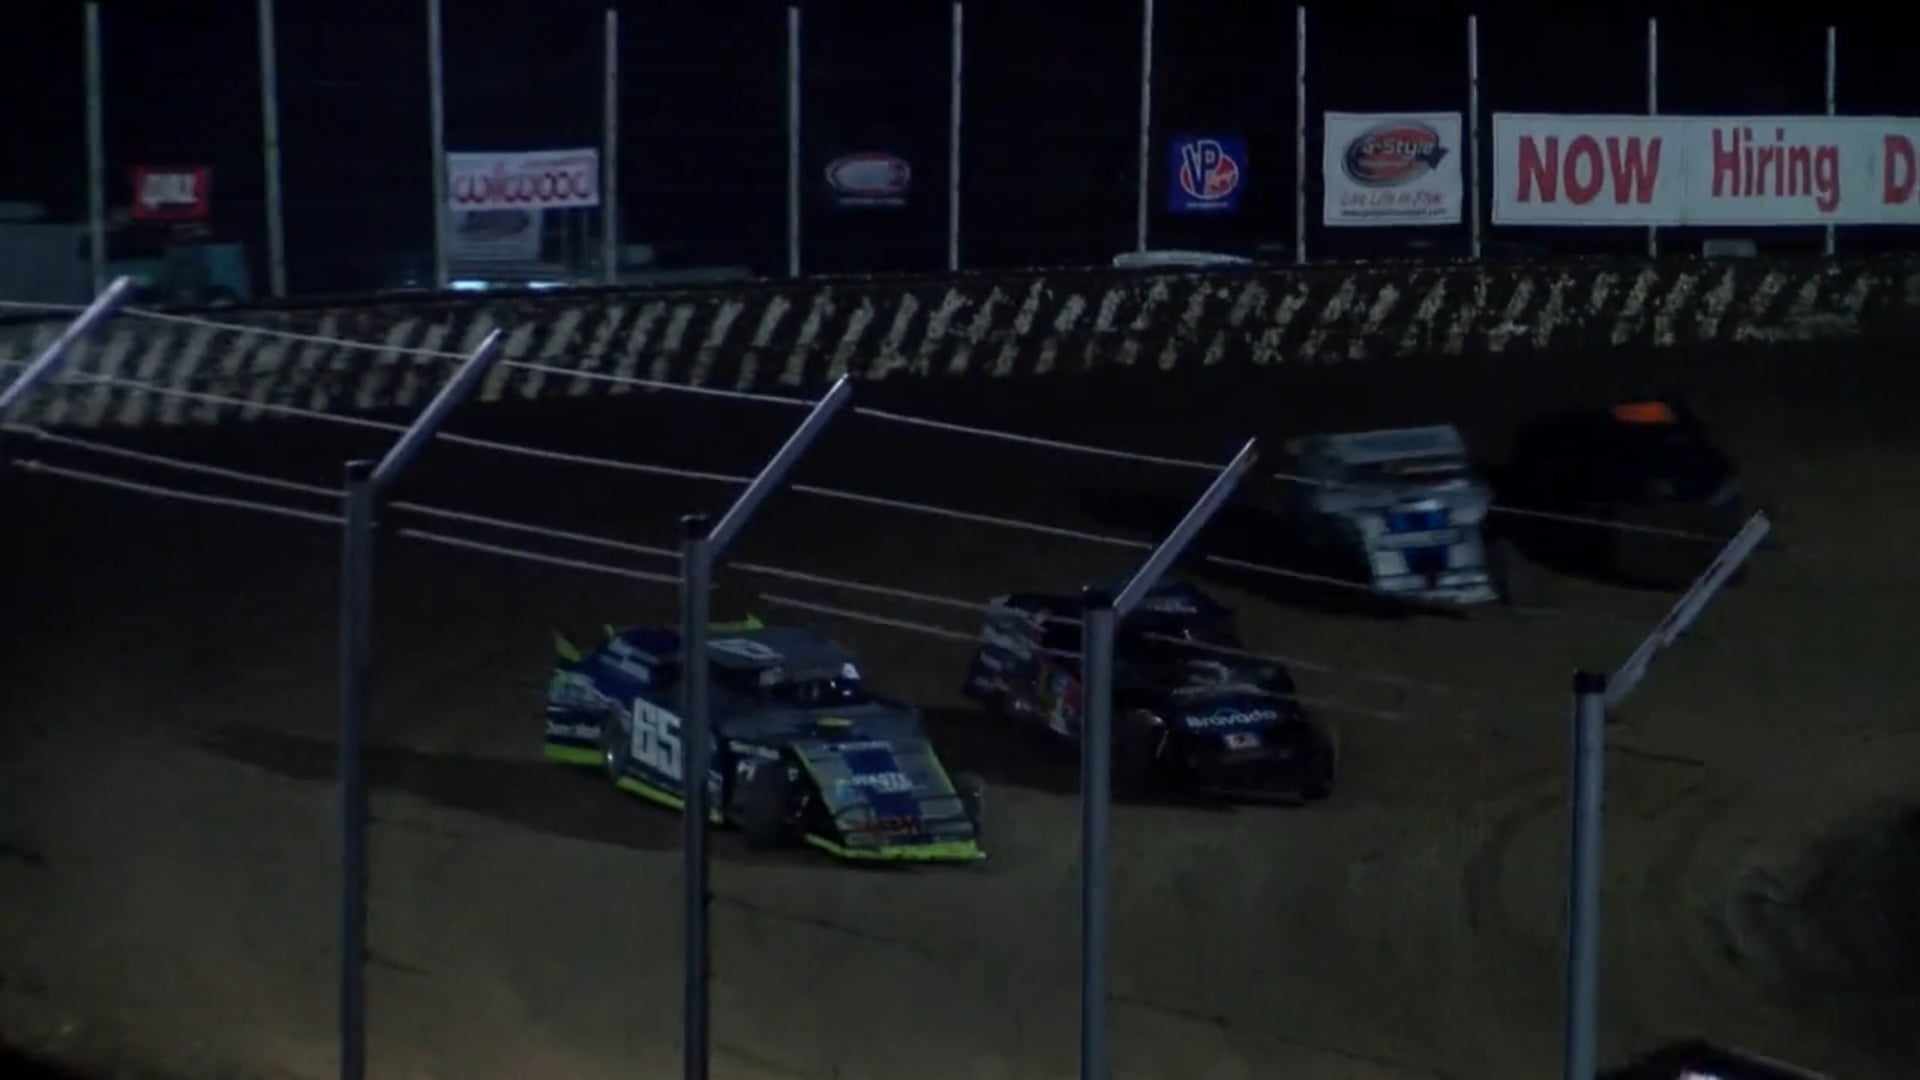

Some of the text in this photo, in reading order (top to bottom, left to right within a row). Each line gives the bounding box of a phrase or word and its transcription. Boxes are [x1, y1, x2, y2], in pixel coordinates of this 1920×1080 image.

[1182, 140, 1222, 198] VP
[1516, 134, 1661, 205] NOW
[1712, 127, 1840, 213] Hiring
[631, 697, 683, 780] 65
[1185, 708, 1278, 728] Bravado
